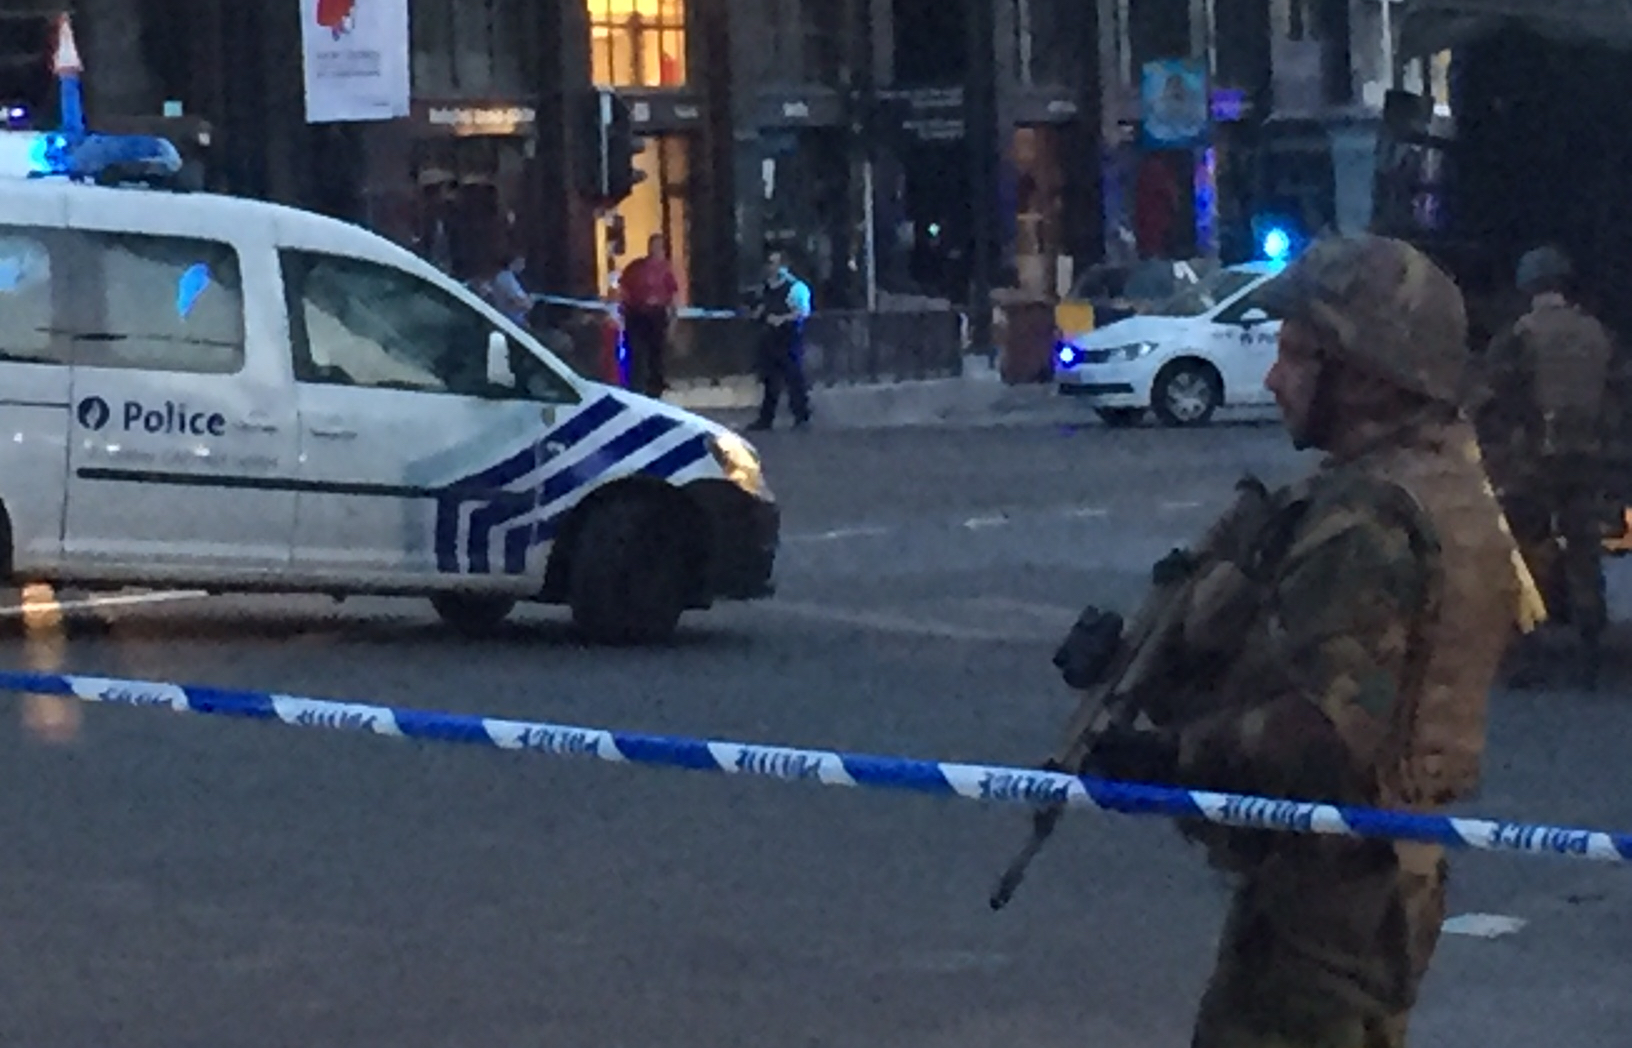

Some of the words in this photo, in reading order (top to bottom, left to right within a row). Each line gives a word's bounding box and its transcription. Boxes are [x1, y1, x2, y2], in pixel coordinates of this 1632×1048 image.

[122, 400, 226, 437] Police
[978, 770, 1069, 804] POLICE
[1488, 822, 1589, 854] POLICE
